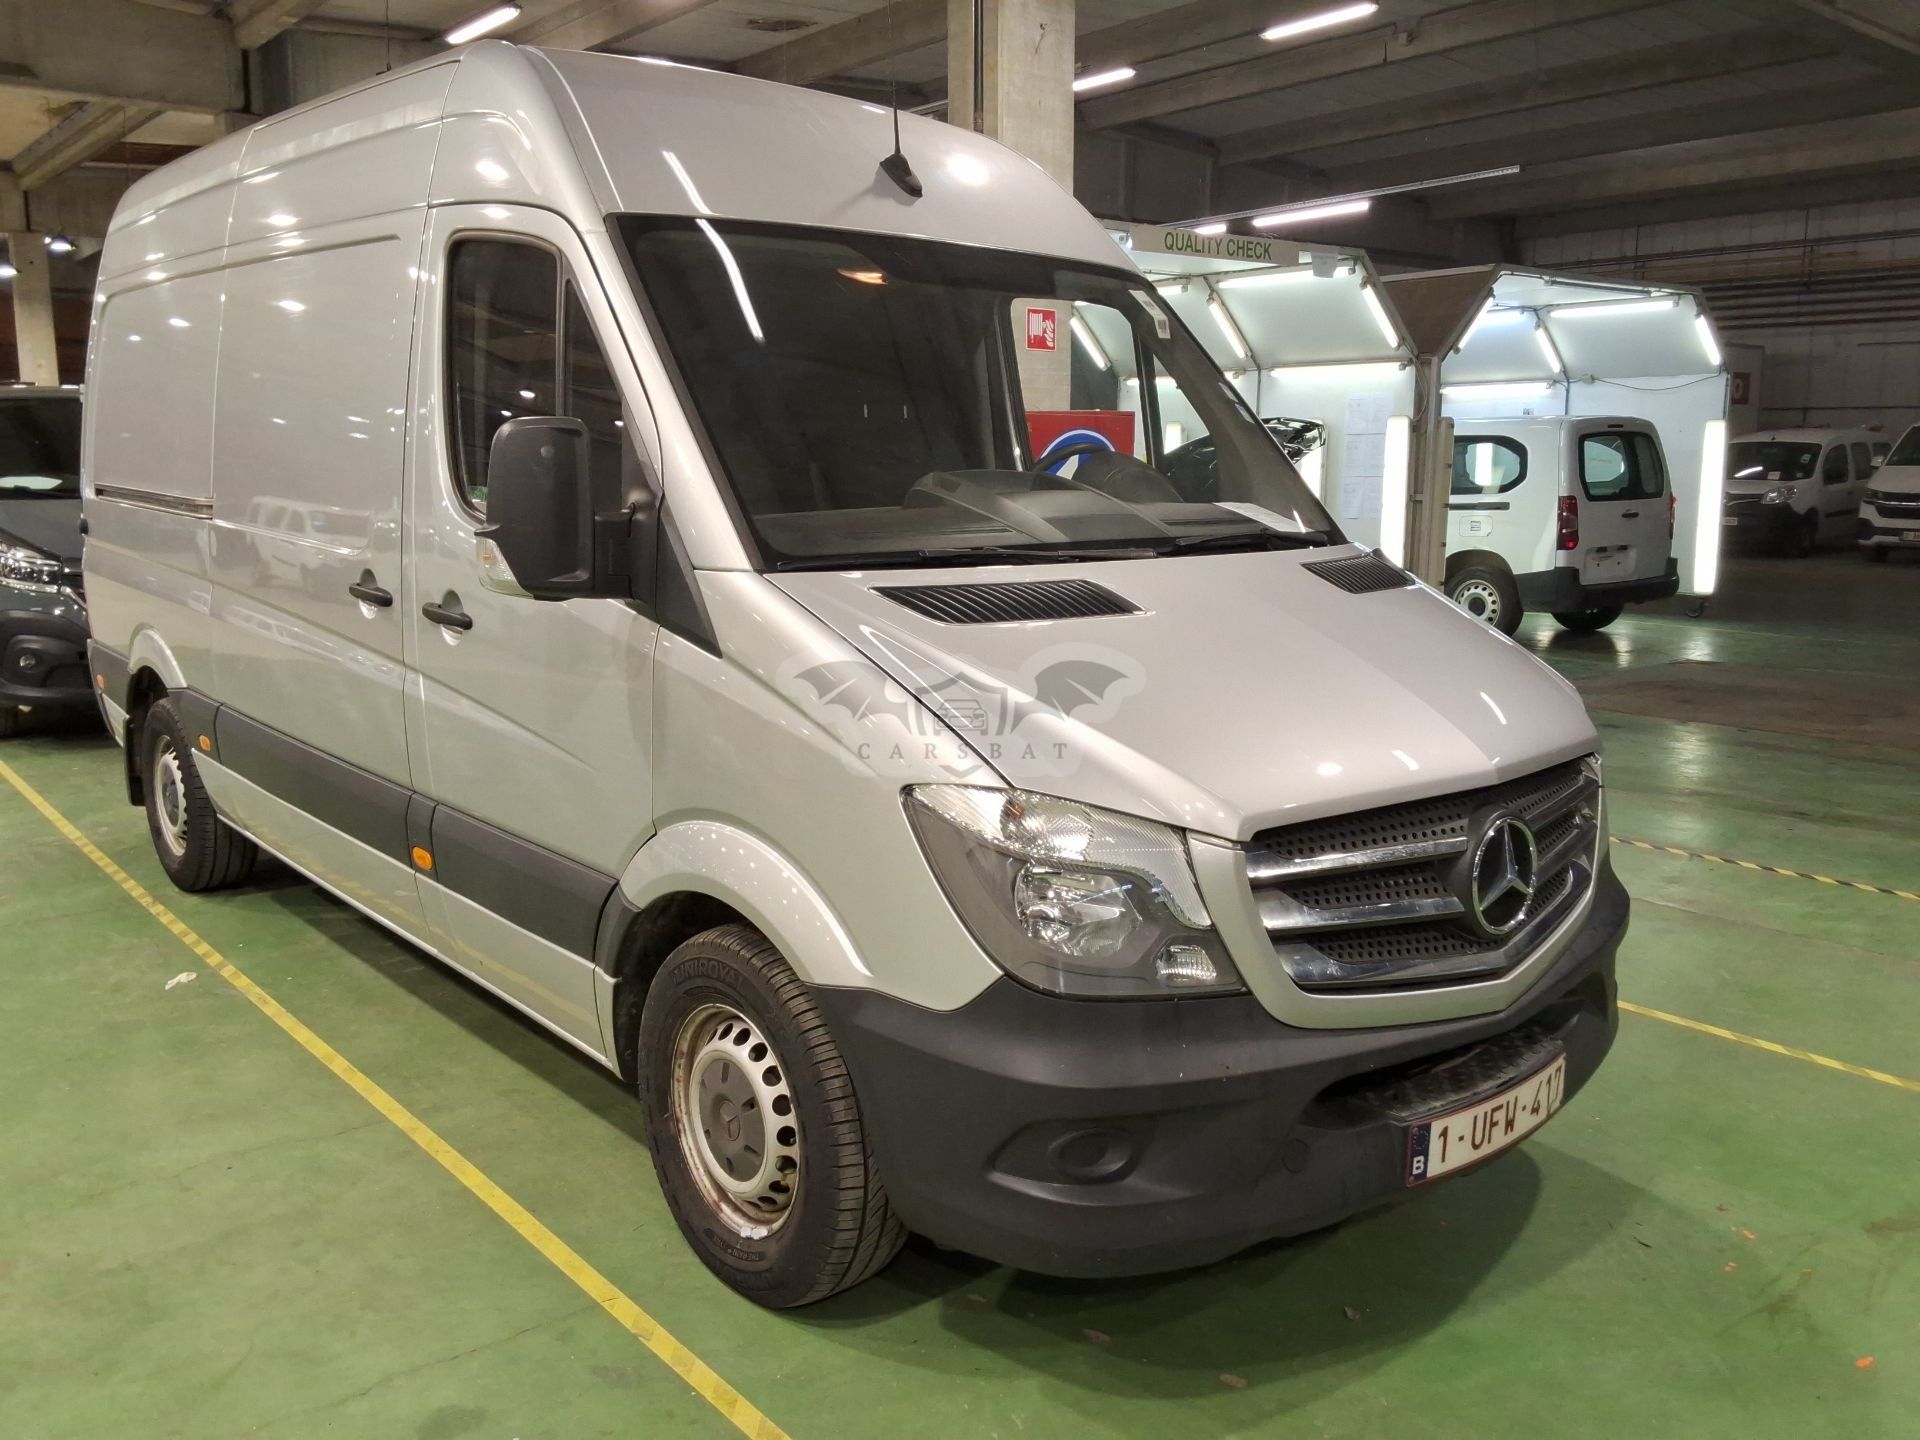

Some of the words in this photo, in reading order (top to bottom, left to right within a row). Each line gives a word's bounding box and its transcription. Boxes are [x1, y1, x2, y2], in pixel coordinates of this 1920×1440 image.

[1164, 231, 1223, 254] QUALITY
[1227, 238, 1271, 260] CHECK
[1412, 1154, 1425, 1175] B
